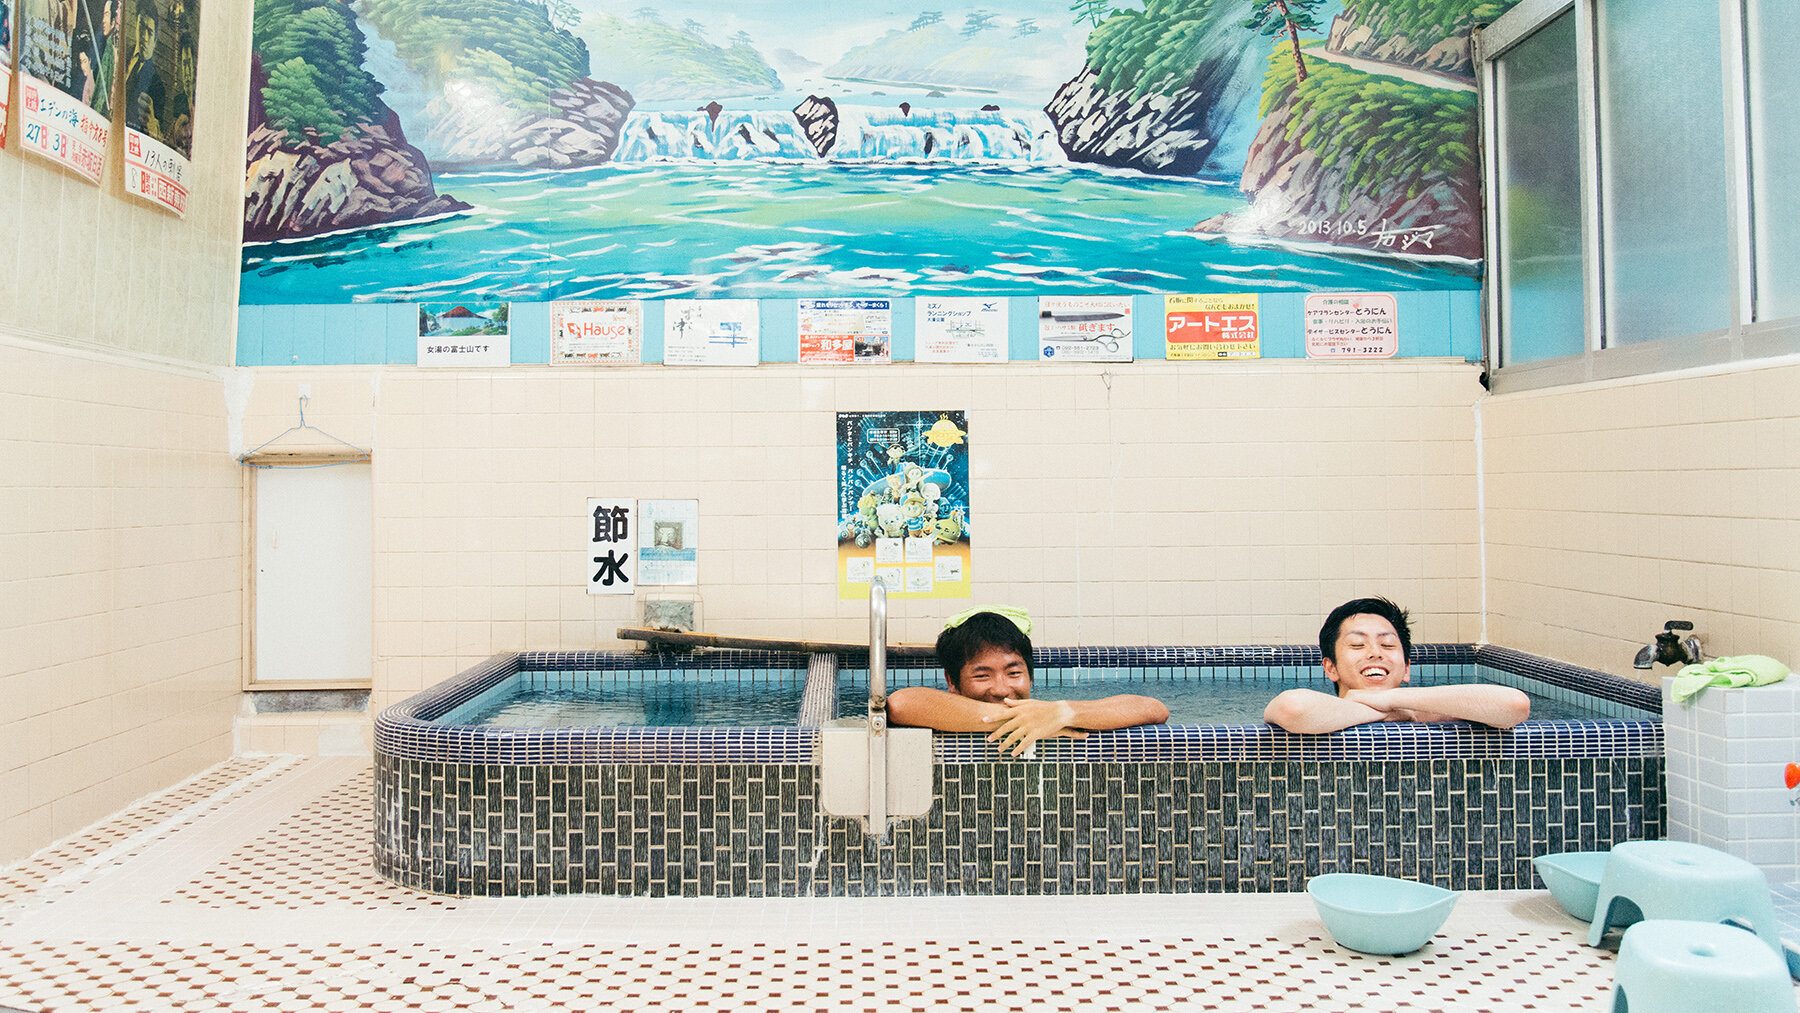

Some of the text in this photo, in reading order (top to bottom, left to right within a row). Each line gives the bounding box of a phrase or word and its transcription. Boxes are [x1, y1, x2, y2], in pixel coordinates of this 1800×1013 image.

[1297, 220, 1367, 235] 2013.10.5
[583, 322, 626, 340] Hause
[1168, 315, 1256, 333] アートエス
[427, 345, 490, 354] 女湯の富士山です
[592, 505, 629, 586] 節水
